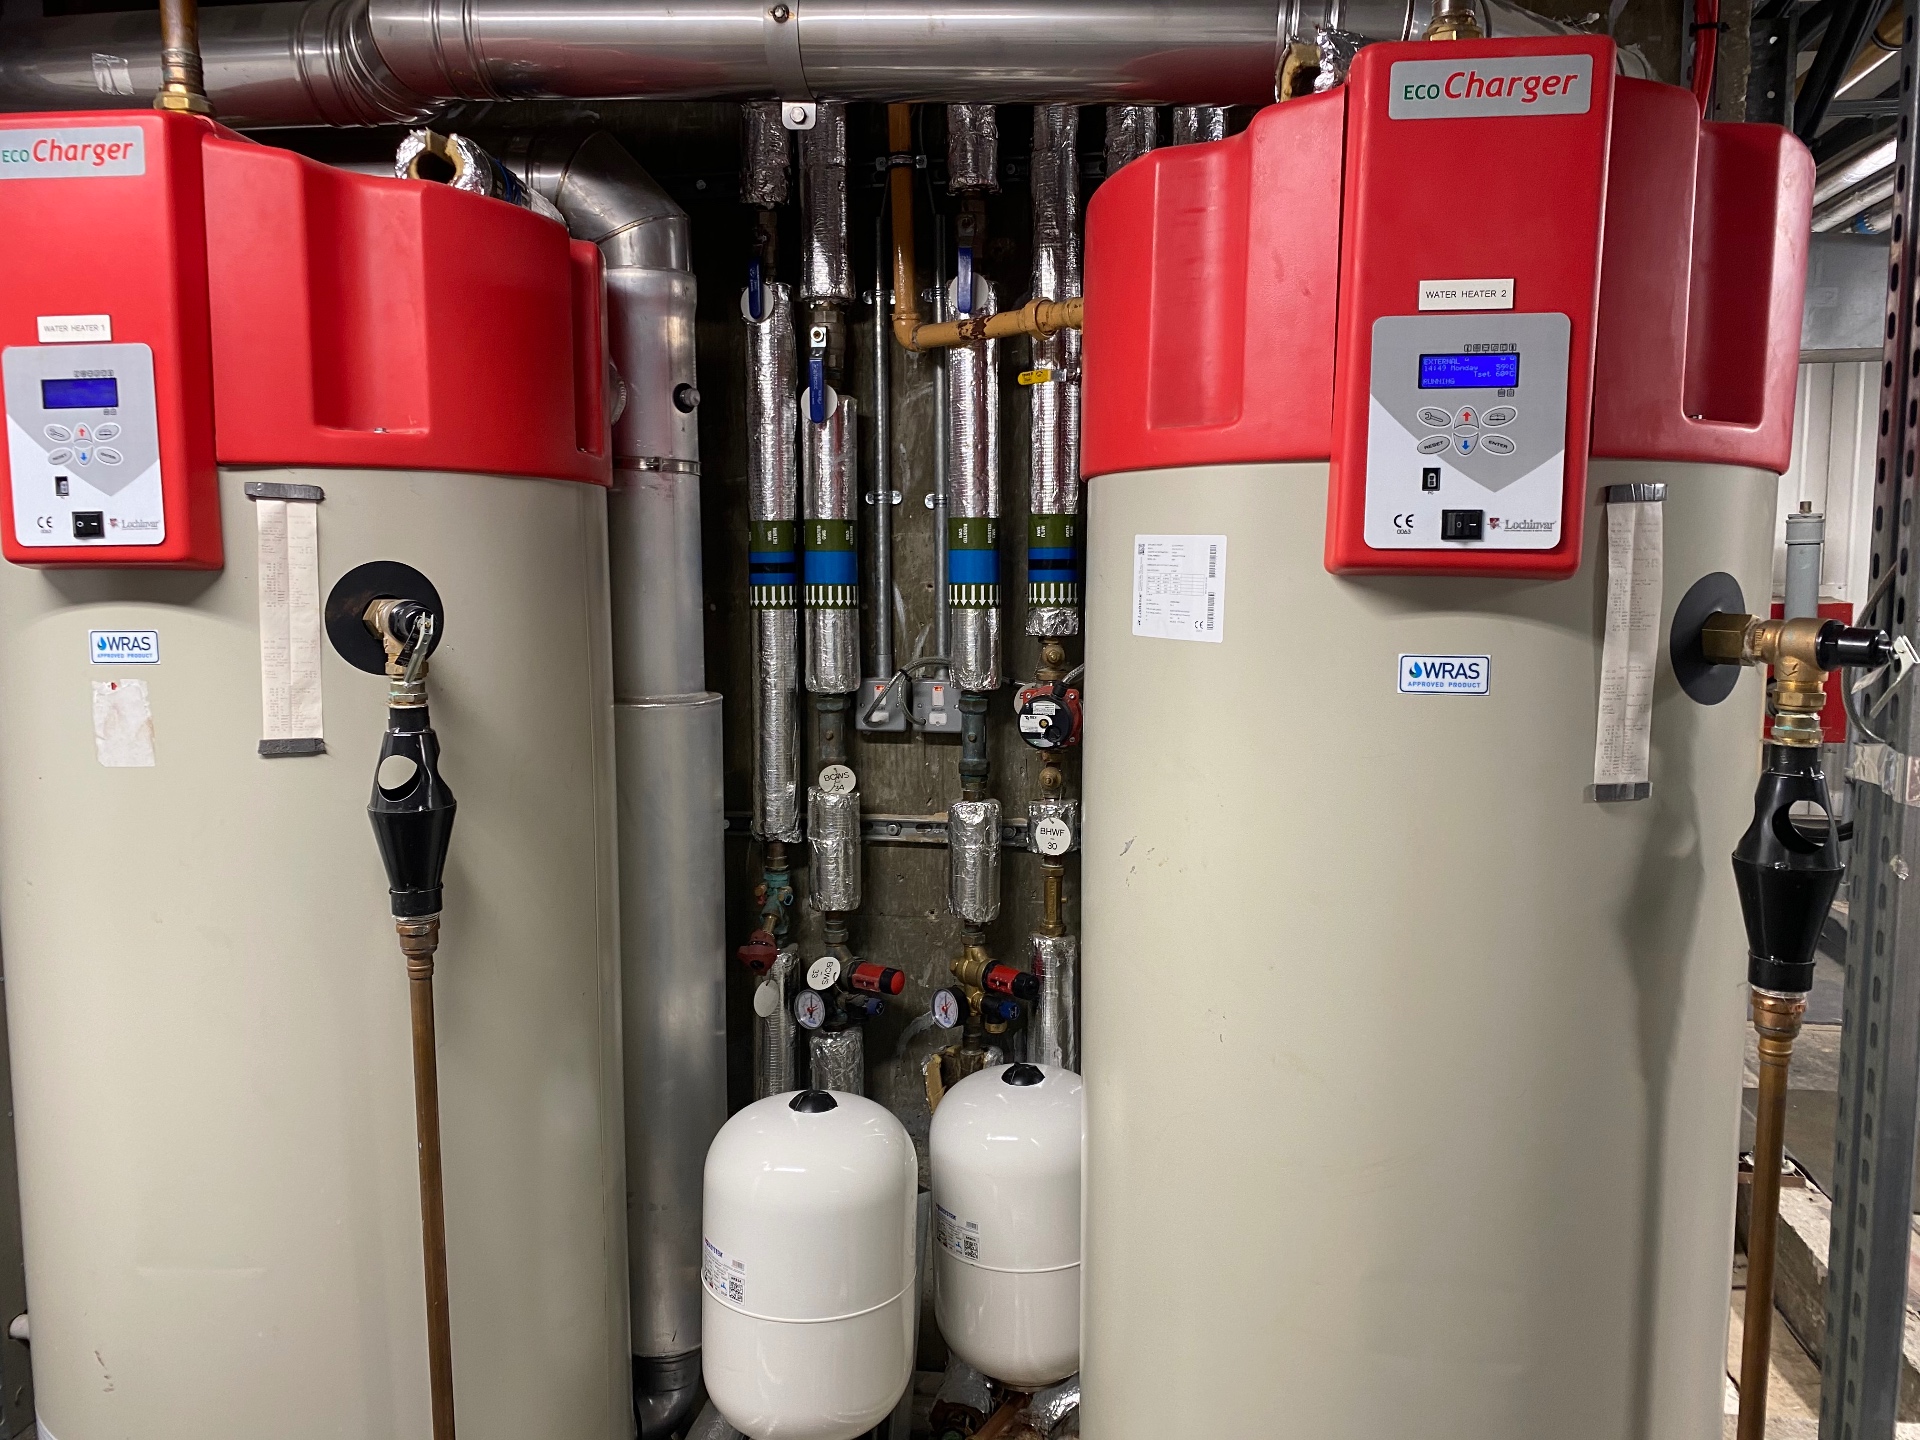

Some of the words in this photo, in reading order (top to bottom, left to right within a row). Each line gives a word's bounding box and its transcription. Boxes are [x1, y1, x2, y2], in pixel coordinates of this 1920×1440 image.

[1403, 85, 1440, 100] ECO
[1444, 71, 1578, 103] Charger
[2, 150, 30, 163] ECO
[33, 139, 134, 167] Charger
[1425, 290, 1457, 299] WATER
[1461, 289, 1497, 298] HEATER
[1501, 290, 1507, 298] 2
[70, 324, 100, 332] HEATER
[1424, 440, 1444, 450] RESET
[1488, 440, 1508, 450] ENTER
[1504, 519, 1557, 531] Lochinvar
[106, 636, 151, 651] WRAS
[1423, 662, 1480, 680] WRAS
[1040, 828, 1065, 836] BHWF
[1048, 842, 1058, 850] 30
[812, 969, 820, 979] 33
[822, 962, 834, 985] BCWS
